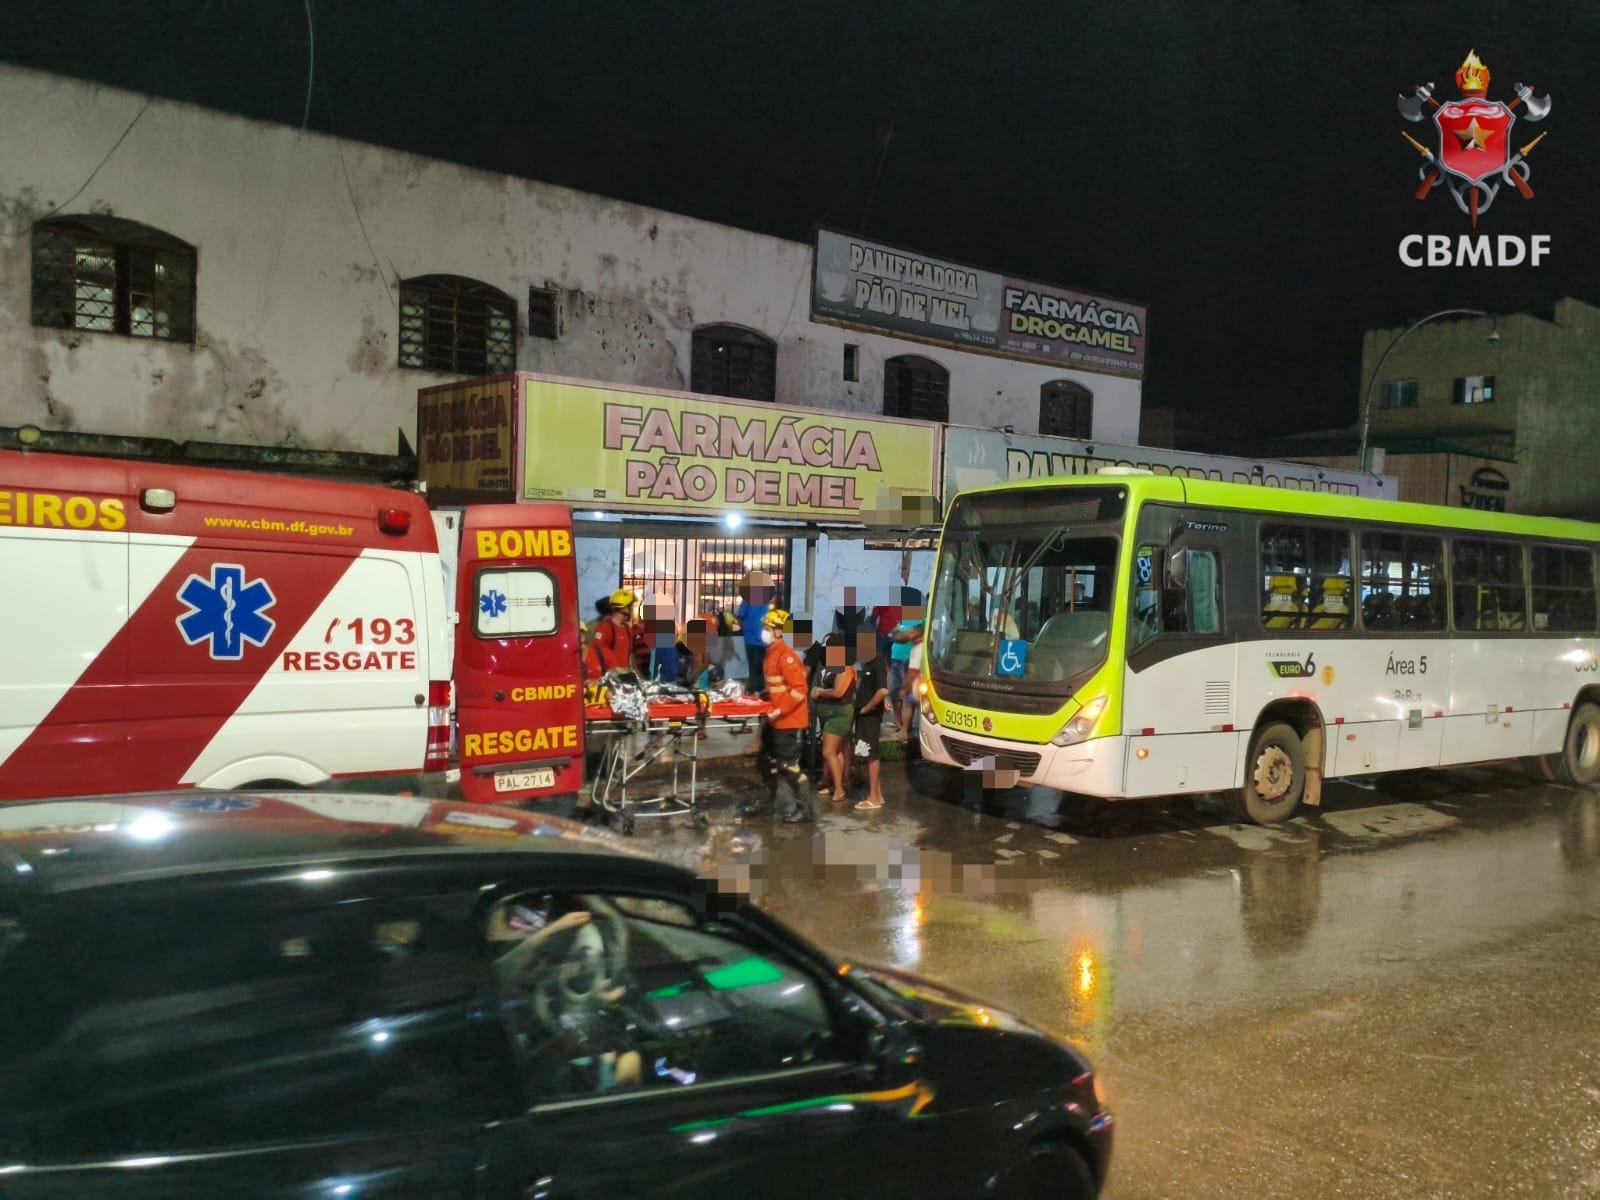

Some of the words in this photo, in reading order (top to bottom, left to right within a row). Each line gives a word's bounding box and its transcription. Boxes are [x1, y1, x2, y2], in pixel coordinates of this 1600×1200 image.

[850, 243, 978, 299] PANIFICADORA
[854, 277, 897, 315] PÃO
[900, 290, 927, 322] DE
[930, 296, 971, 331] MEL
[1004, 286, 1140, 335] FARMÁCIA
[1010, 311, 1136, 354] DROGAMEL
[603, 402, 882, 472] FARMÁCIA
[625, 457, 718, 502] PÃO
[724, 470, 781, 506] DE
[786, 473, 865, 510] MEL
[204, 516, 355, 536] www.cbm.df.gov.br
[1186, 521, 1228, 532] Torino
[476, 530, 571, 559] BOMB
[347, 618, 416, 646] 193
[283, 651, 416, 671] RESGATE
[1280, 665, 1301, 674] EURO
[1304, 652, 1316, 678] 6
[1385, 650, 1415, 675] Área
[1419, 655, 1427, 674] 5
[511, 684, 577, 702] CBMDF
[945, 710, 978, 728] 503151
[465, 725, 577, 757] RESGATE
